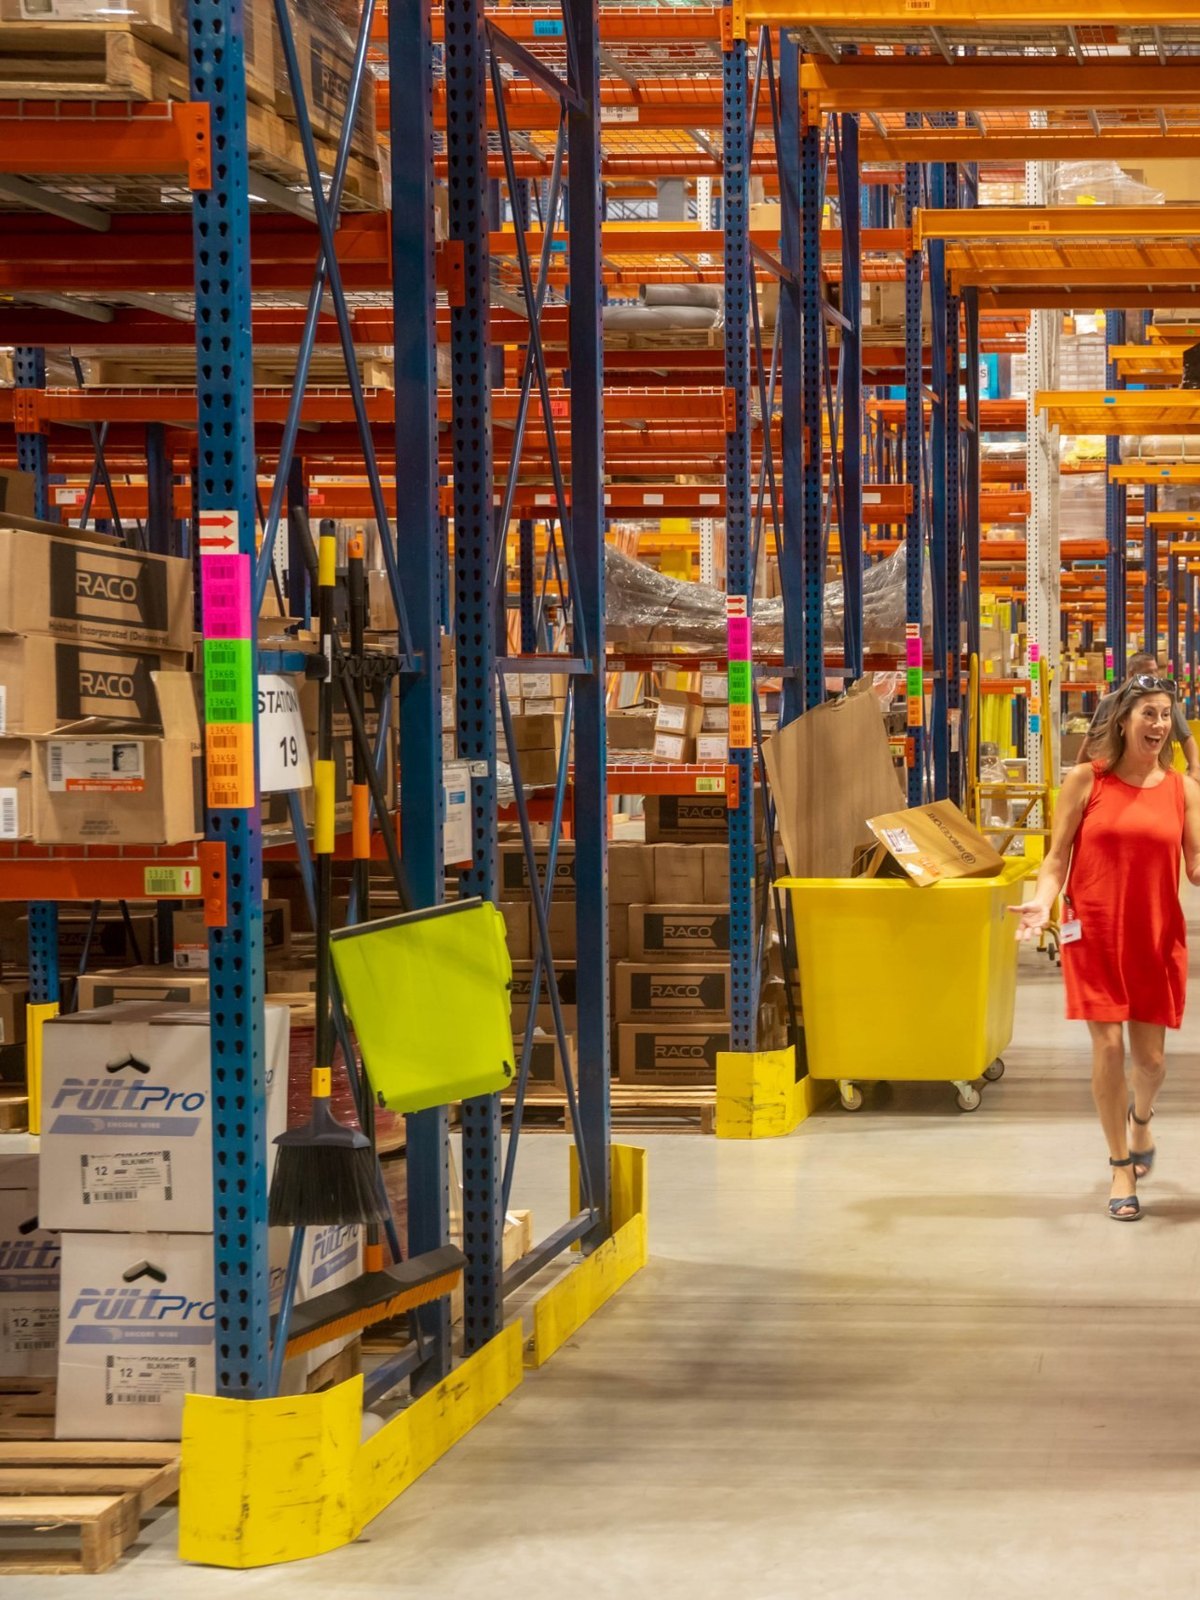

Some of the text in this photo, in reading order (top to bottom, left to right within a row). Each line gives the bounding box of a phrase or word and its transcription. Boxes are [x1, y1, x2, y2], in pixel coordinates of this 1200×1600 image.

[75, 572, 137, 601] RACO
[79, 672, 134, 698] RACO
[258, 690, 299, 714] STATION
[280, 736, 299, 768] 19
[677, 807, 724, 818] RACO
[522, 865, 571, 876] RAO
[662, 926, 711, 938] RACO
[650, 985, 700, 998] RACO
[654, 1045, 704, 1058] RACO
[50, 1078, 205, 1113] PULLPro
[94, 1166, 109, 1177] 12
[13, 1317, 29, 1328] 12
[119, 1367, 133, 1378] 12
